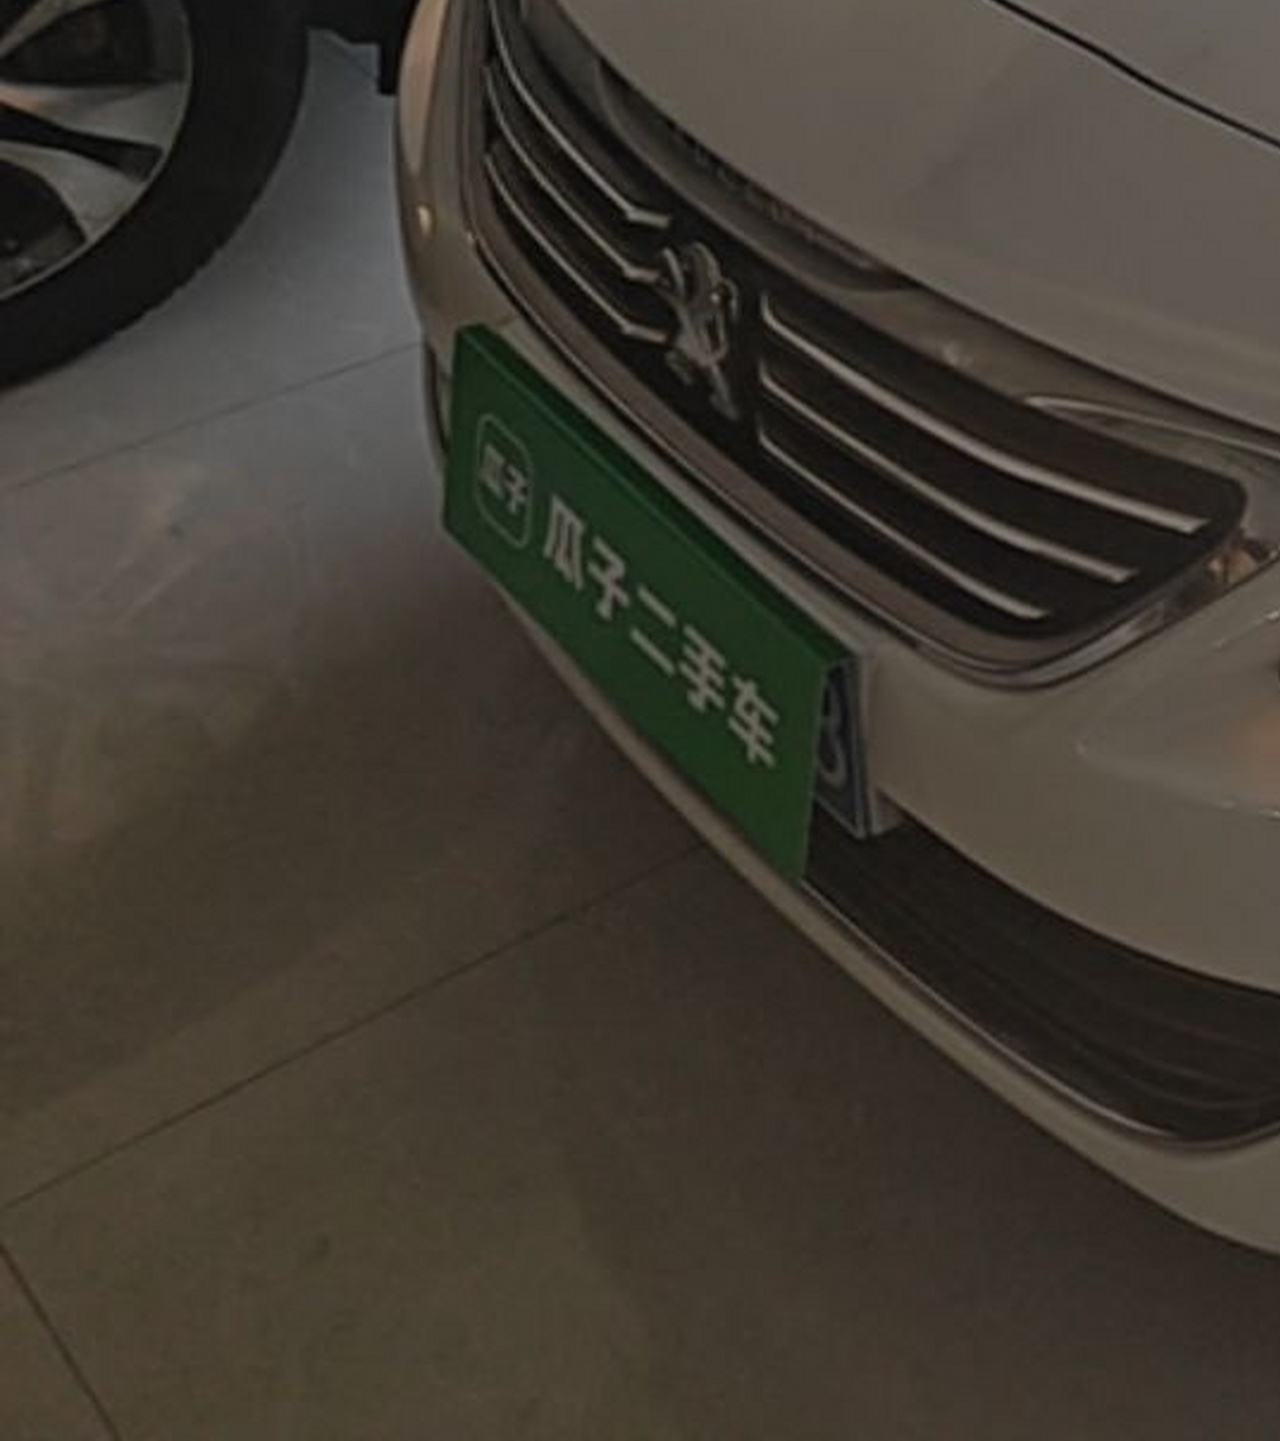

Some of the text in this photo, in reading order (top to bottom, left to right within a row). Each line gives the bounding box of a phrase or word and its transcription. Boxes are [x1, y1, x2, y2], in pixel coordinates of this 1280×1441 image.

[543, 492, 781, 769] 瓜子二手车
